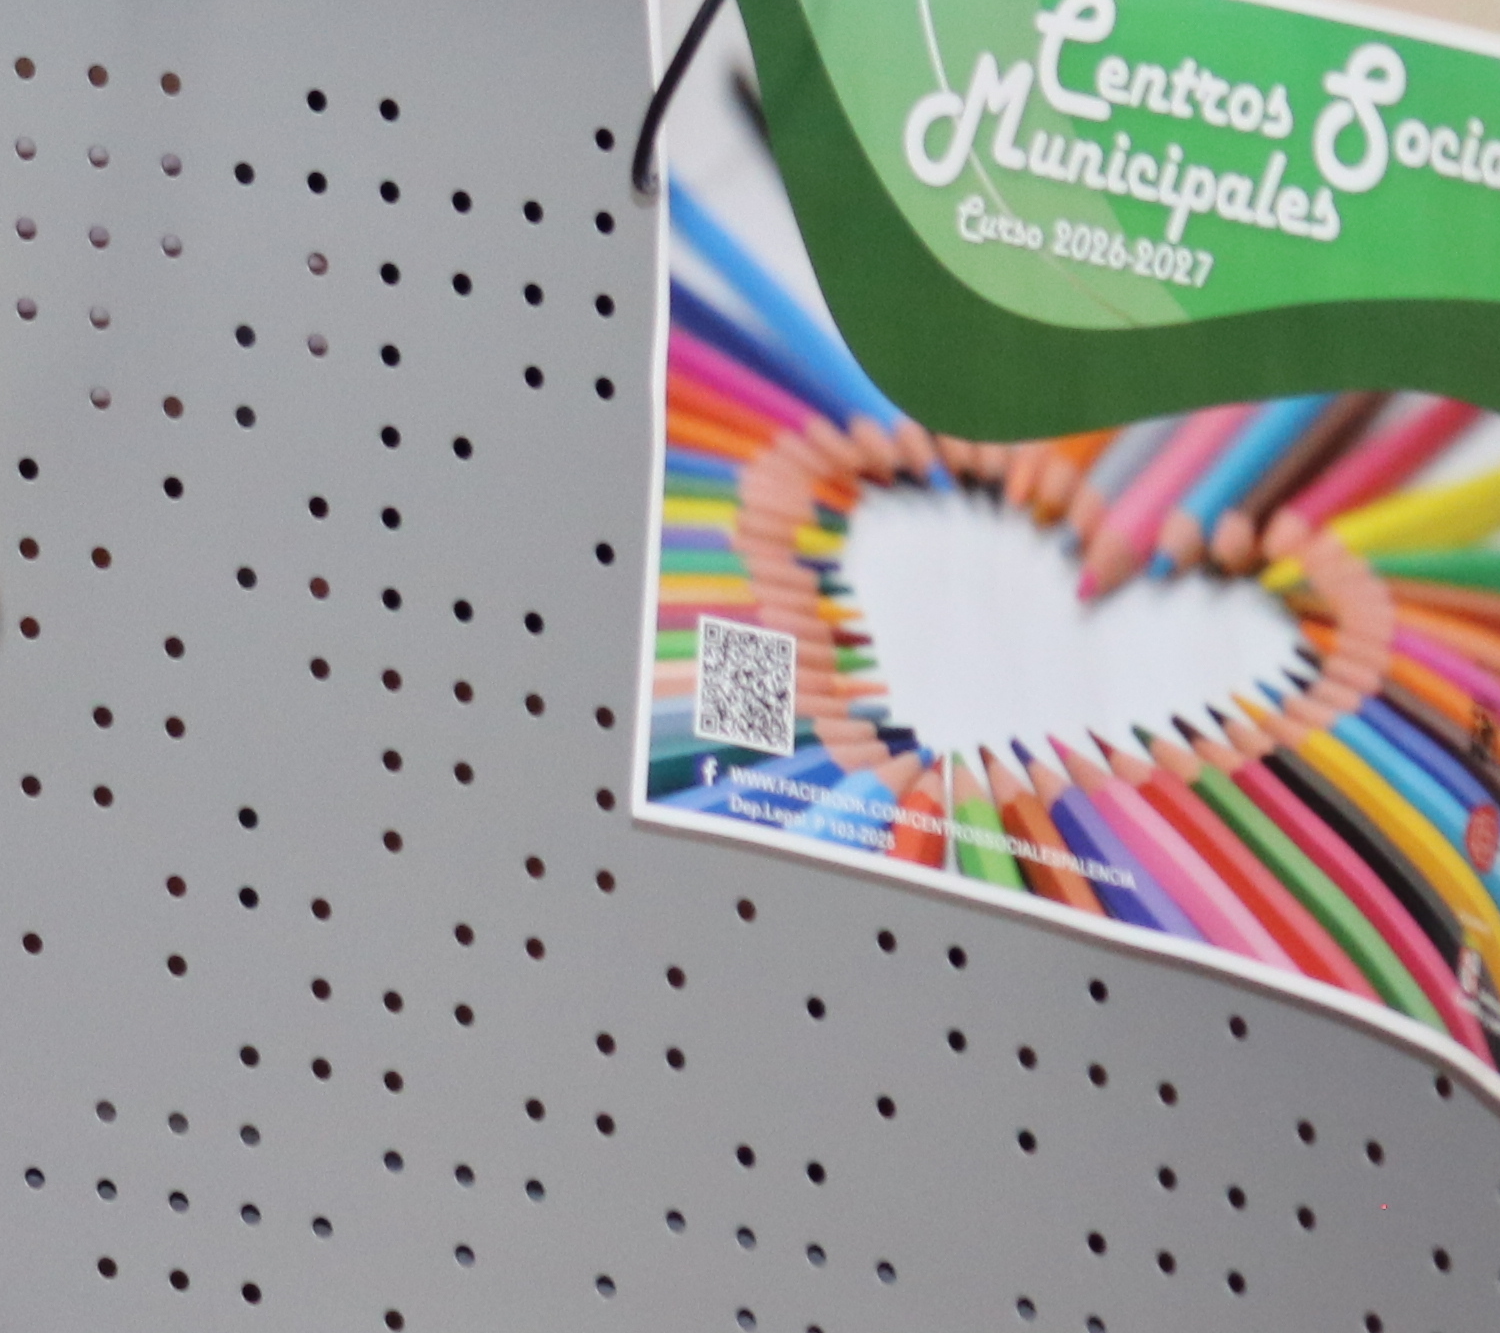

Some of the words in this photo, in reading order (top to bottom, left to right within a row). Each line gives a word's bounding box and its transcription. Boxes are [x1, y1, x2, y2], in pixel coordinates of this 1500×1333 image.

[904, 51, 1342, 242] Municipales
[955, 196, 1044, 253] Curso
[1053, 221, 1215, 290] 2026-2027
